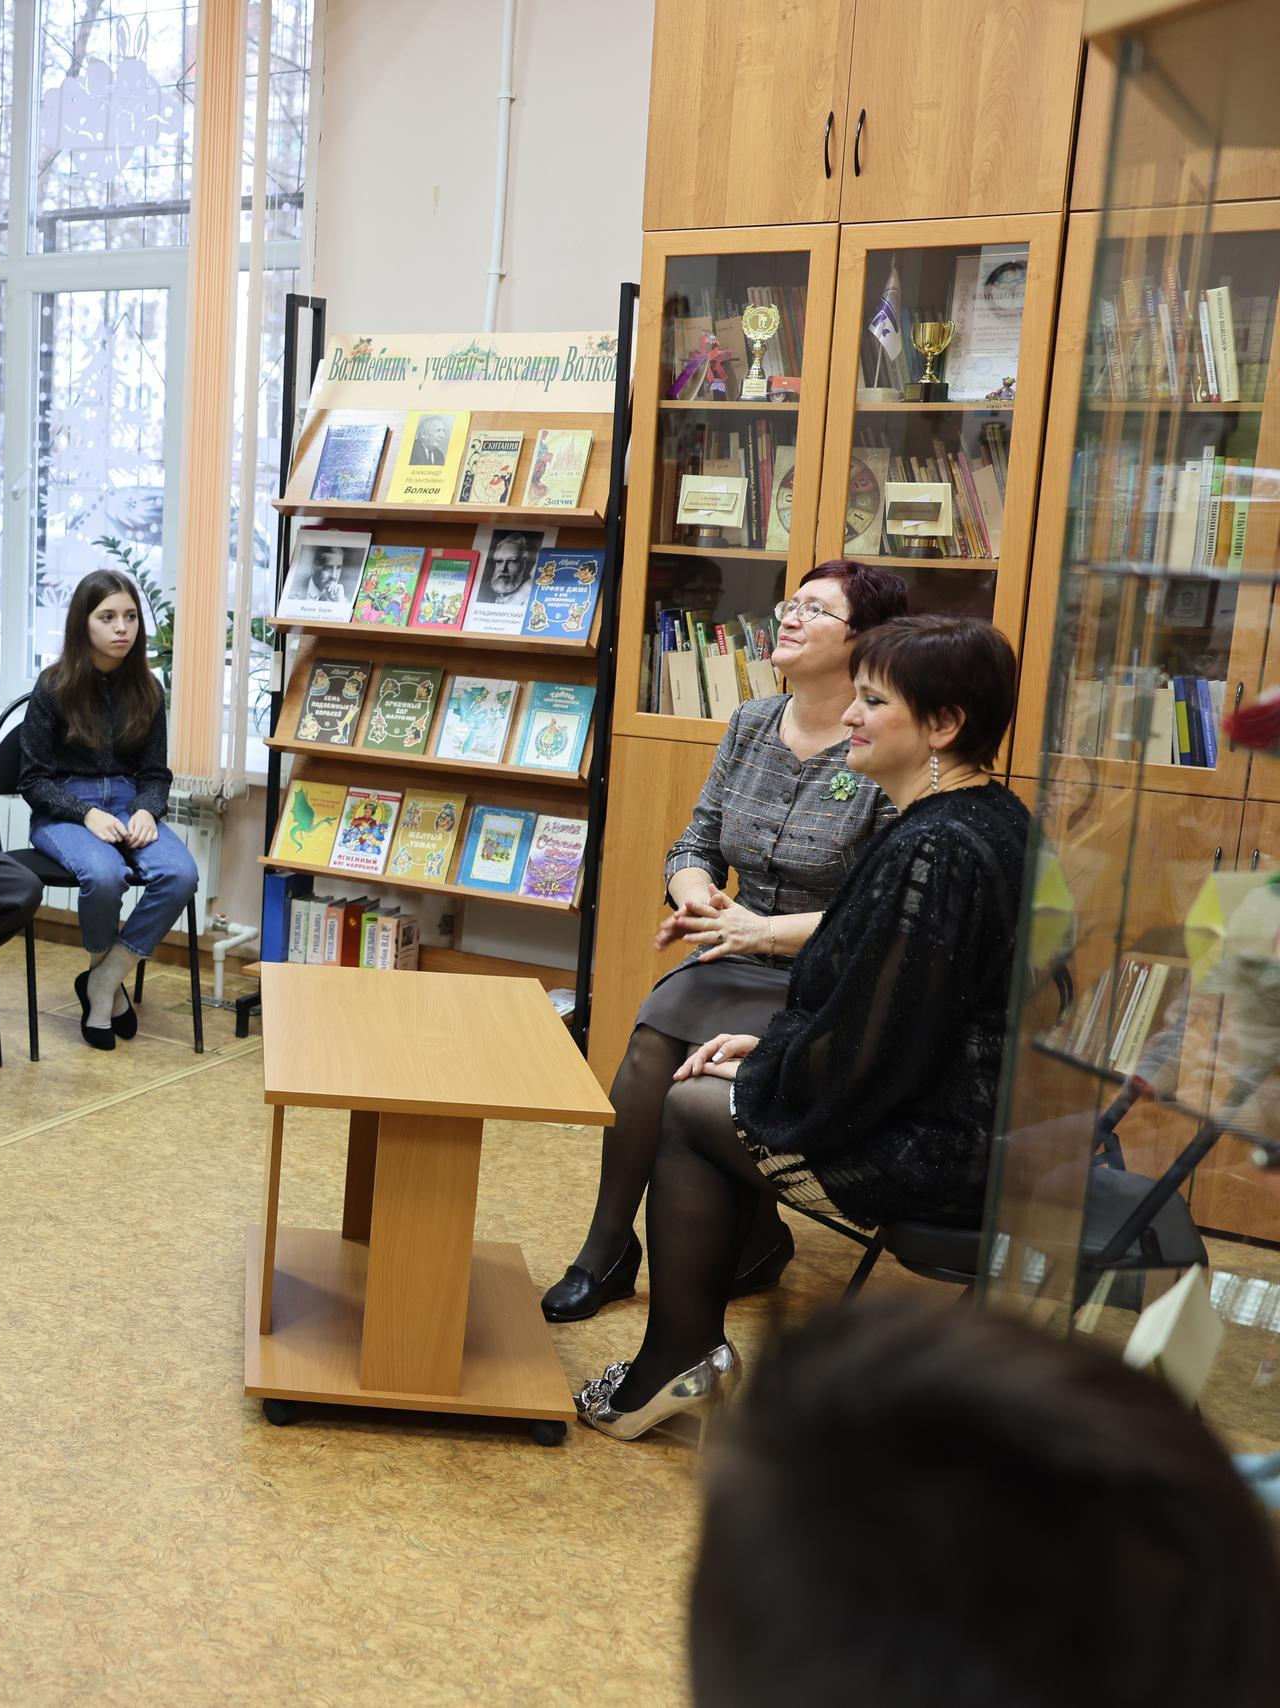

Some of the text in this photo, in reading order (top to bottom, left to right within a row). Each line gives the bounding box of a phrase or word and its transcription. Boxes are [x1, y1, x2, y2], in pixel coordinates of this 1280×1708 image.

[328, 347, 411, 382] Волшебник
[476, 346, 560, 393] Александр
[483, 441, 519, 451] СКИТАНИЯ
[404, 485, 441, 496] Волков
[541, 585, 565, 593] УРФИН
[409, 841, 437, 850] ТУМАН
[337, 854, 378, 864] ОГНЕННЫЙ
